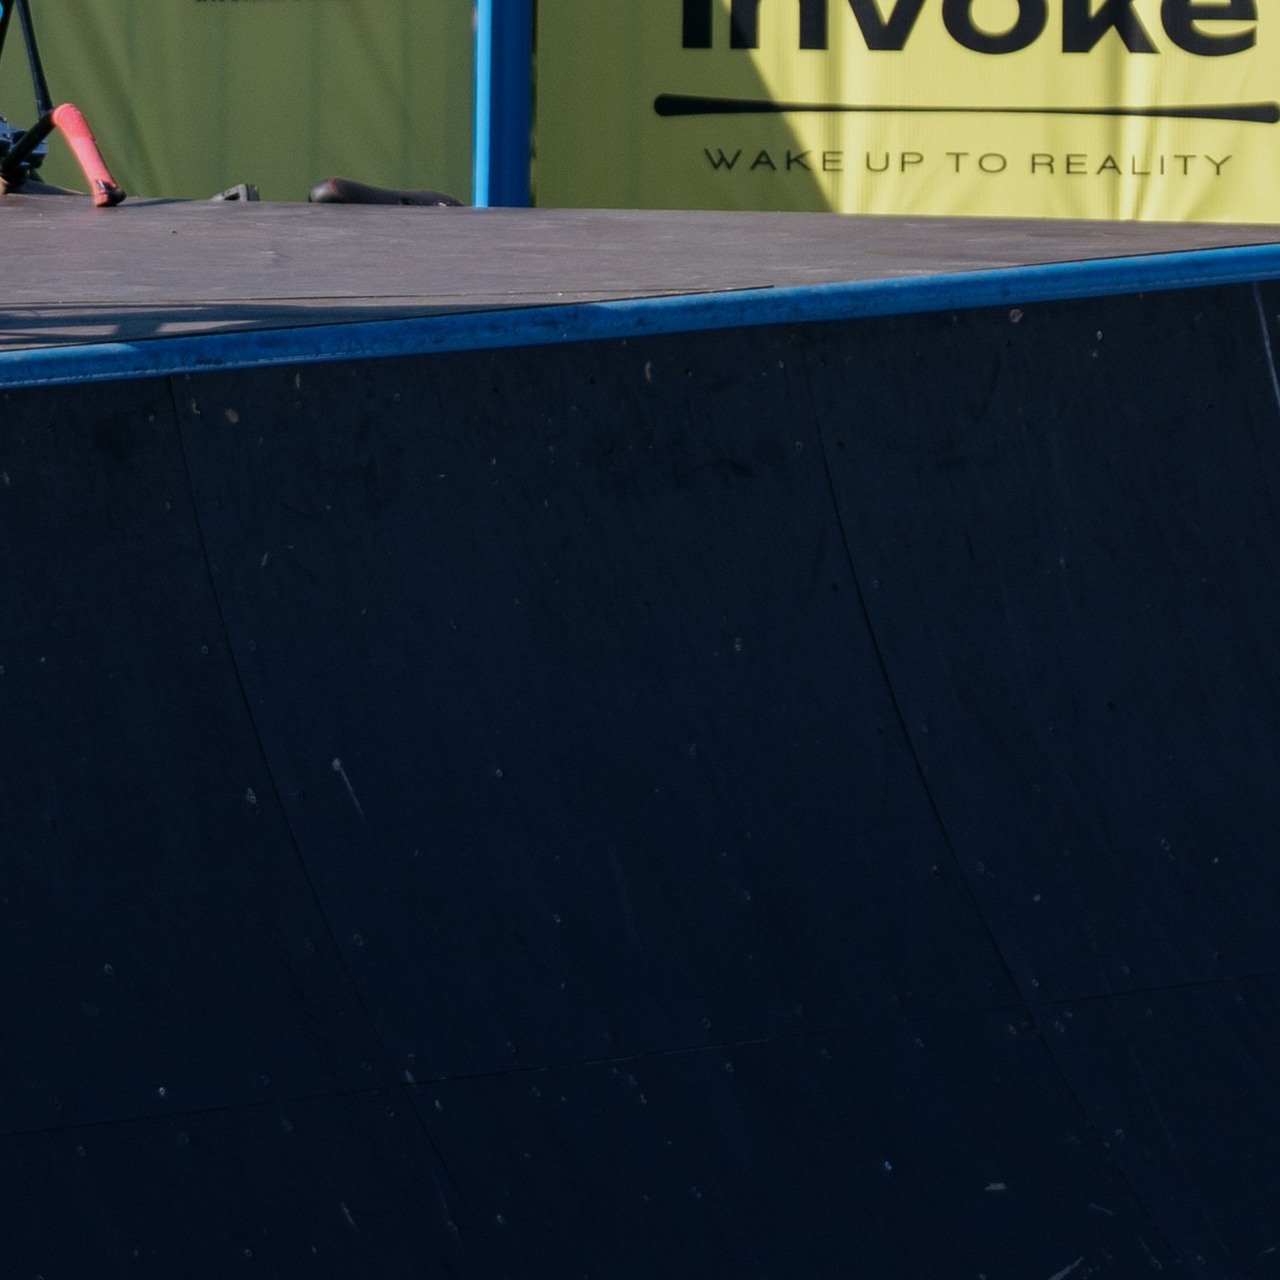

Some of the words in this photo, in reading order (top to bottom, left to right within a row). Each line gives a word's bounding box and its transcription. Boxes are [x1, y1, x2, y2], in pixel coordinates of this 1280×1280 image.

[703, 147, 845, 174] WAKE
[865, 150, 925, 175] UP
[945, 151, 1009, 176] TO
[1029, 152, 1235, 178] REALITY
